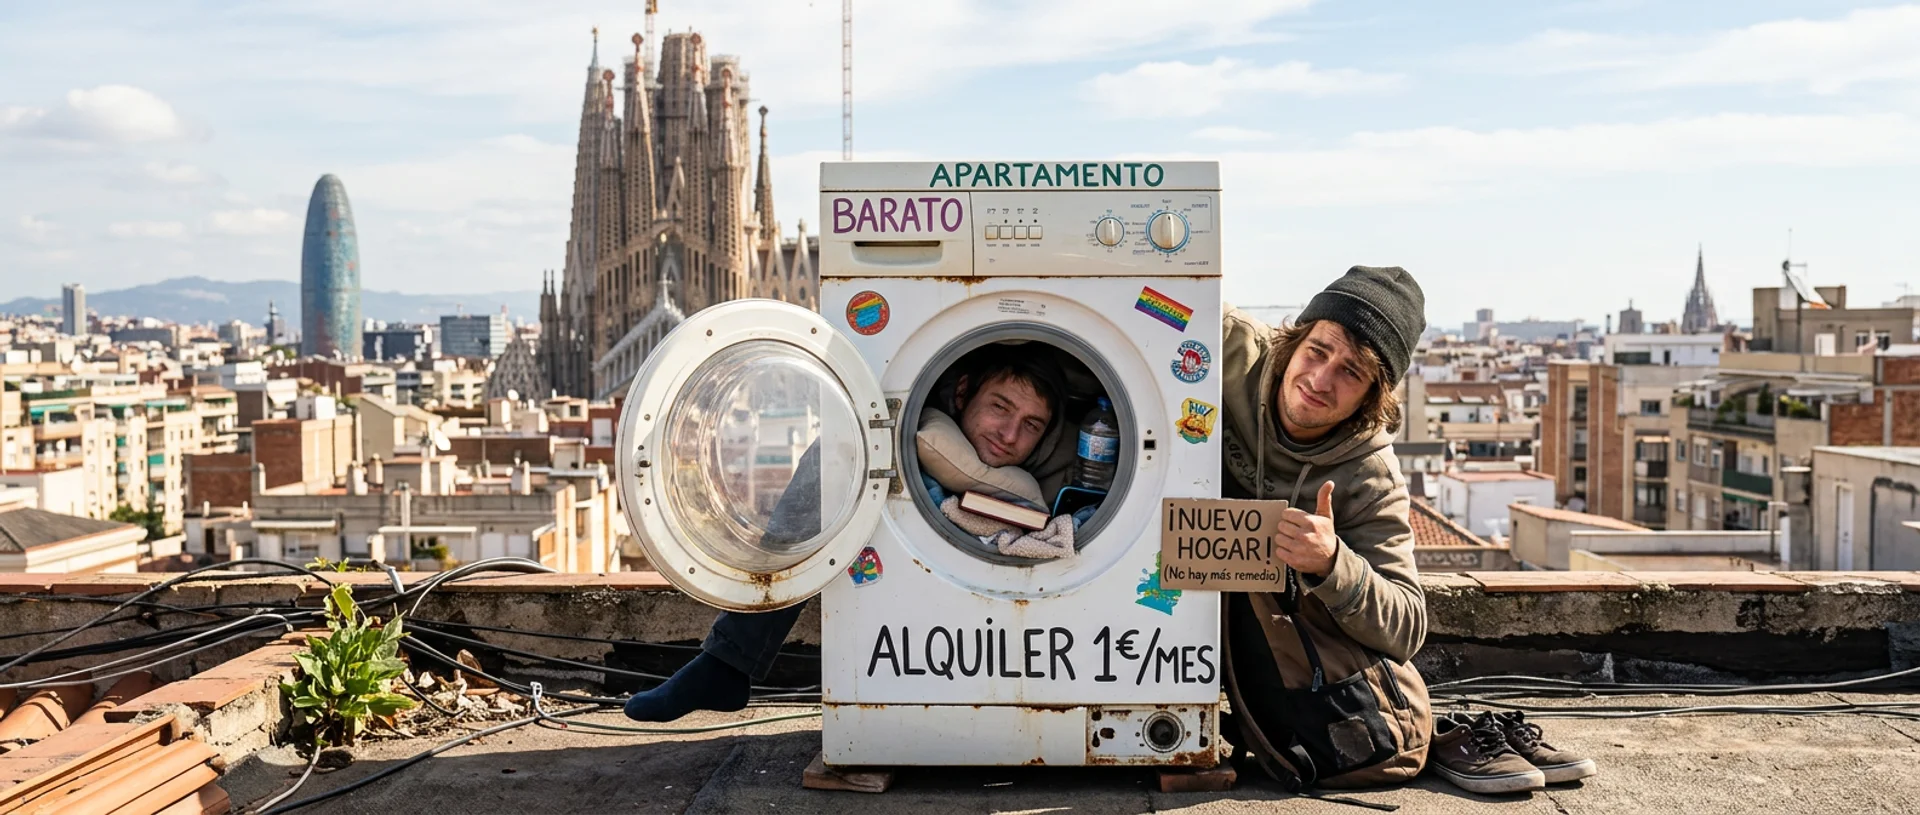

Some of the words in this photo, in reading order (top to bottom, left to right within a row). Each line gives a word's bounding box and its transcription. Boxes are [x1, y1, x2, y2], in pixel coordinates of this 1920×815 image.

[930, 162, 1164, 188] APARTAMENTO
[833, 197, 963, 233] BARATO
[1169, 503, 1262, 532] ¡NUEVO
[1188, 566, 1208, 585] hay
[1210, 568, 1231, 580] más
